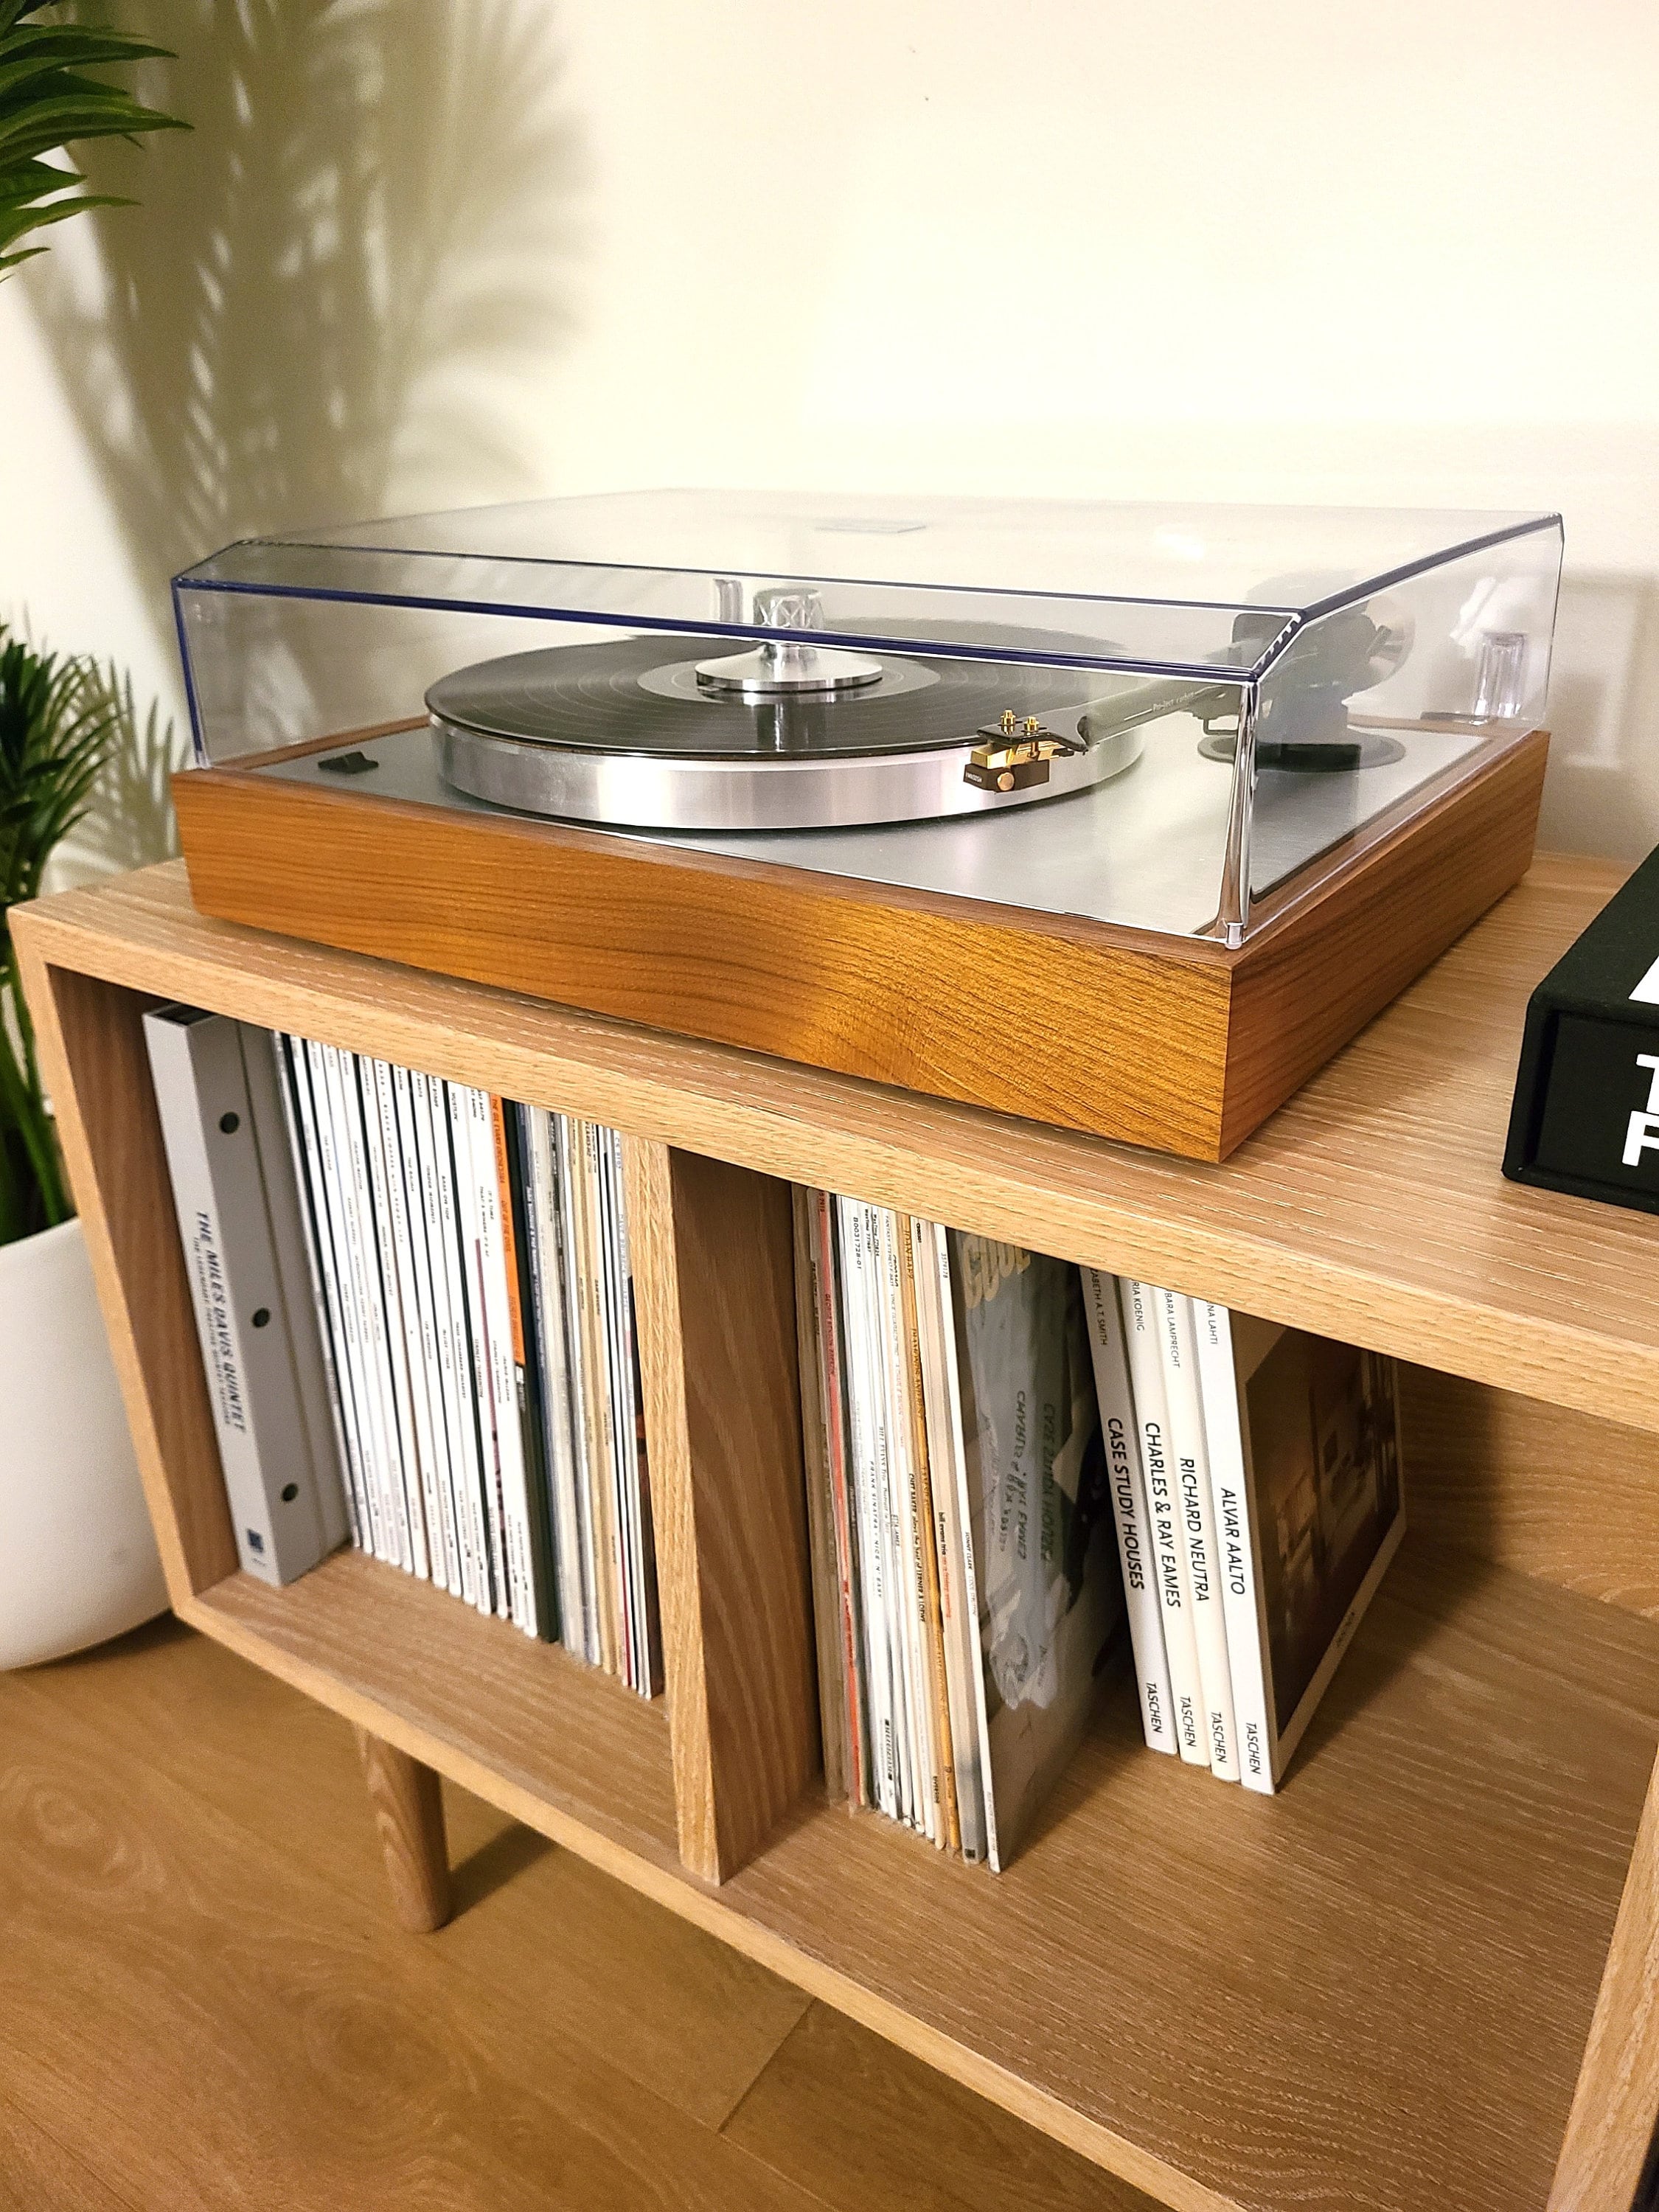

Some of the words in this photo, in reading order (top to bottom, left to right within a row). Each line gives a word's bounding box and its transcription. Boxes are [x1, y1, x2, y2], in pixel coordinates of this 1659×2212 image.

[197, 1211, 212, 1243] THE
[206, 1249, 226, 1304] MILES
[214, 1307, 233, 1360] DAVIS
[1097, 1318, 1107, 1346] SMITH
[1134, 1298, 1144, 1331] KOENIG
[1208, 1318, 1218, 1344] LAHTI
[1166, 1317, 1180, 1368] LAMPRECHT
[223, 1362, 246, 1433] QUINTET
[1107, 1417, 1127, 1461] CASE
[1145, 1422, 1168, 1496] CHARLES
[1114, 1464, 1135, 1519] STUDY
[1155, 1501, 1171, 1514] &
[1180, 1458, 1202, 1533] RICHARD
[1220, 1487, 1240, 1539] ALVAR
[1122, 1522, 1145, 1590] HOUSES
[1157, 1520, 1175, 1550] RAY
[1161, 1554, 1181, 1607] EAMES
[1189, 1537, 1210, 1601] NEUTRA
[1226, 1542, 1245, 1595] AALTO
[1146, 1681, 1163, 1733] TASCHEN
[1180, 1696, 1197, 1747] TASCHEN
[1210, 1711, 1228, 1764] TASCHEN
[1245, 1722, 1262, 1775] TASCHEN
